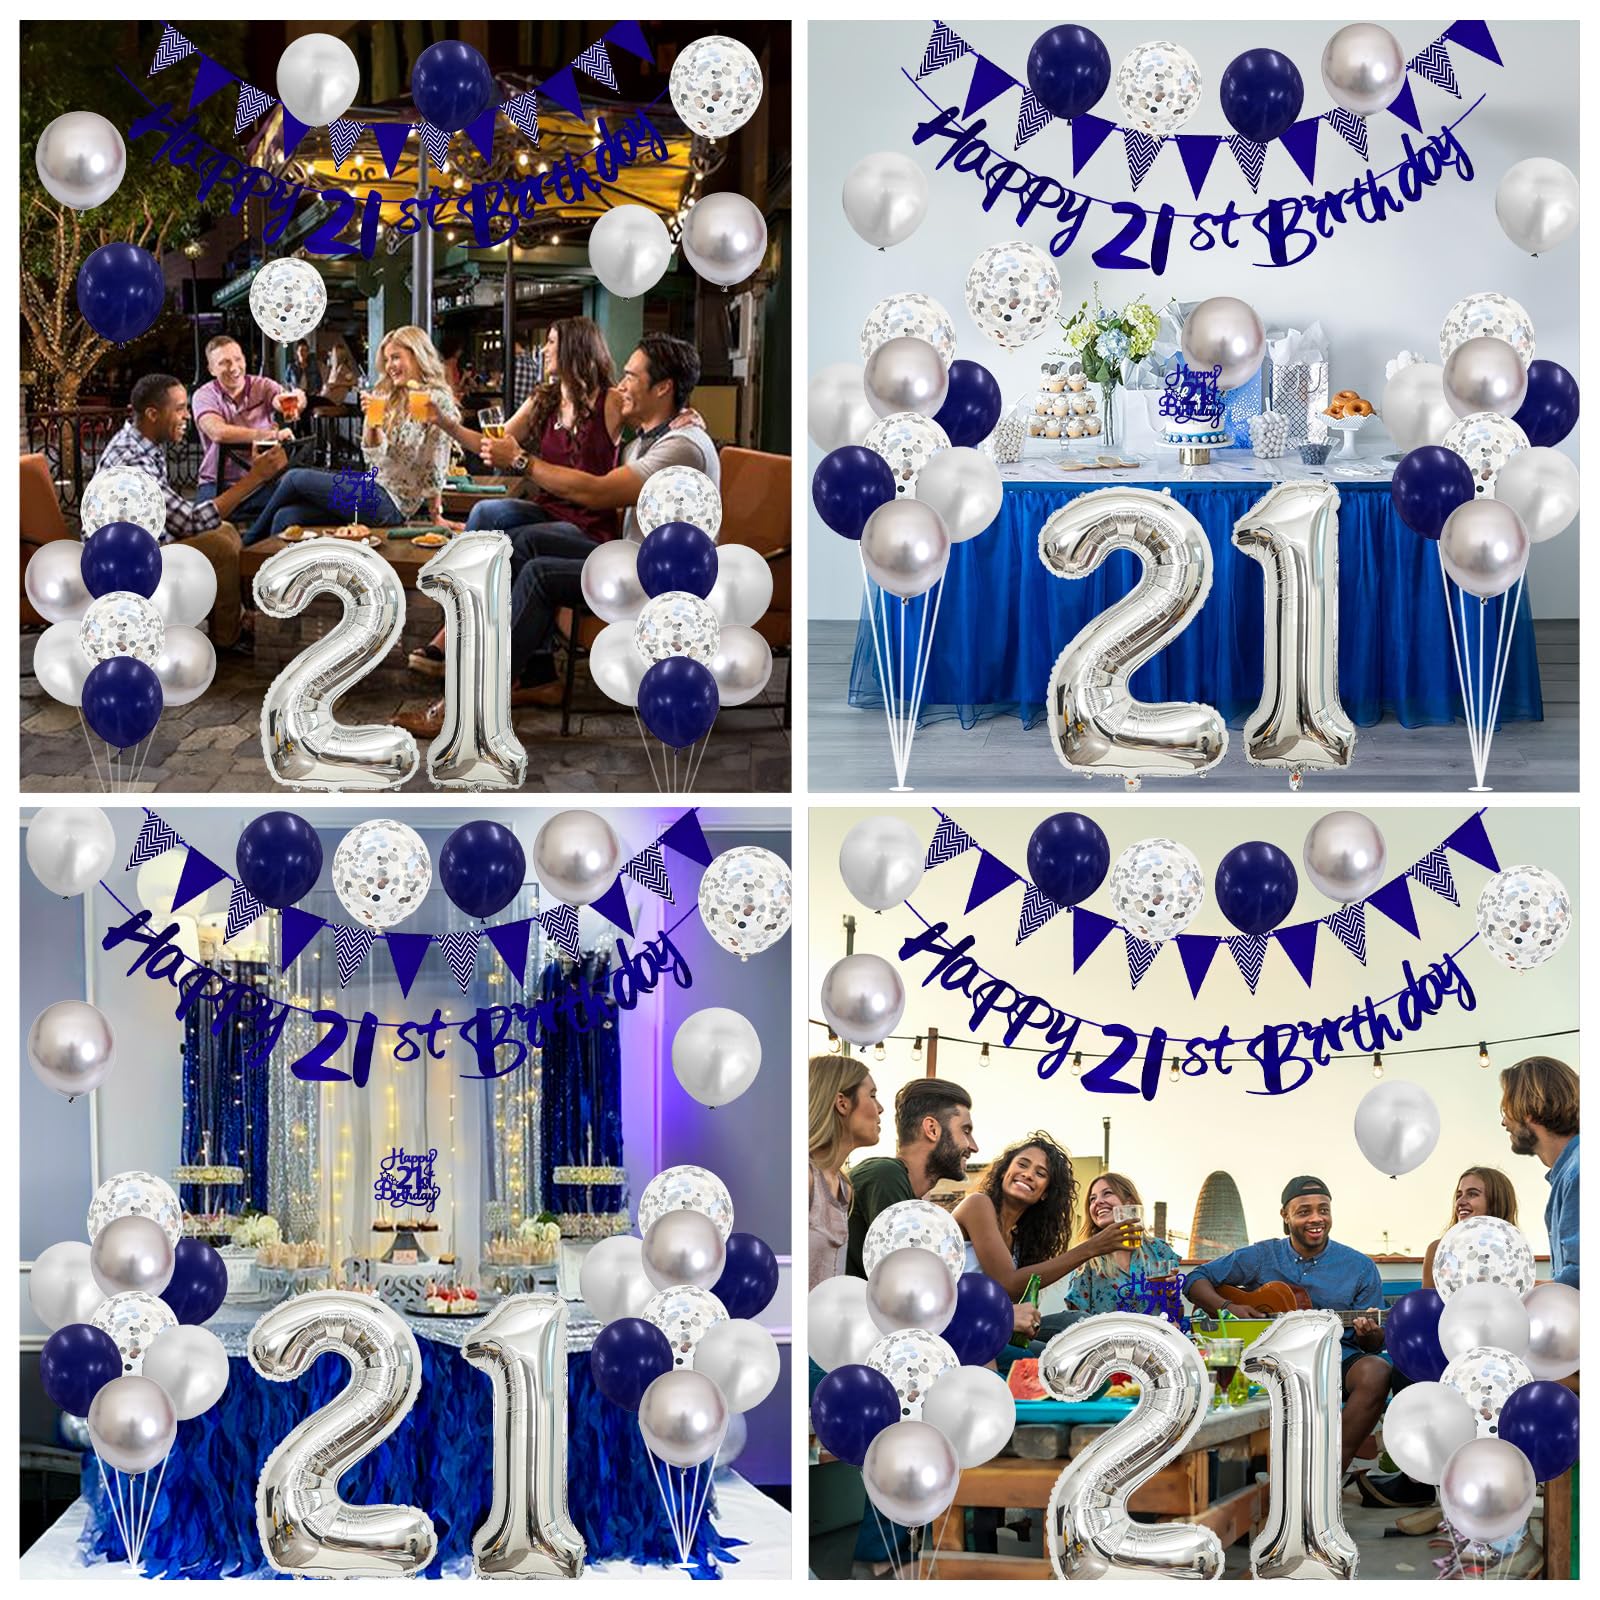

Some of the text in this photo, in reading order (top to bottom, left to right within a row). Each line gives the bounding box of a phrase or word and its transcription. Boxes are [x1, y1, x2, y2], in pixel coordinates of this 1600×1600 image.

[128, 102, 304, 245] Happy
[456, 108, 668, 249] Birthday
[912, 106, 1092, 257] Happy
[1252, 126, 1474, 268] Birthday
[898, 921, 1082, 1080] Happy
[1245, 952, 1477, 1096] Birthday
[373, 1178, 441, 1213] Birthday
[380, 1147, 437, 1175] Happy
